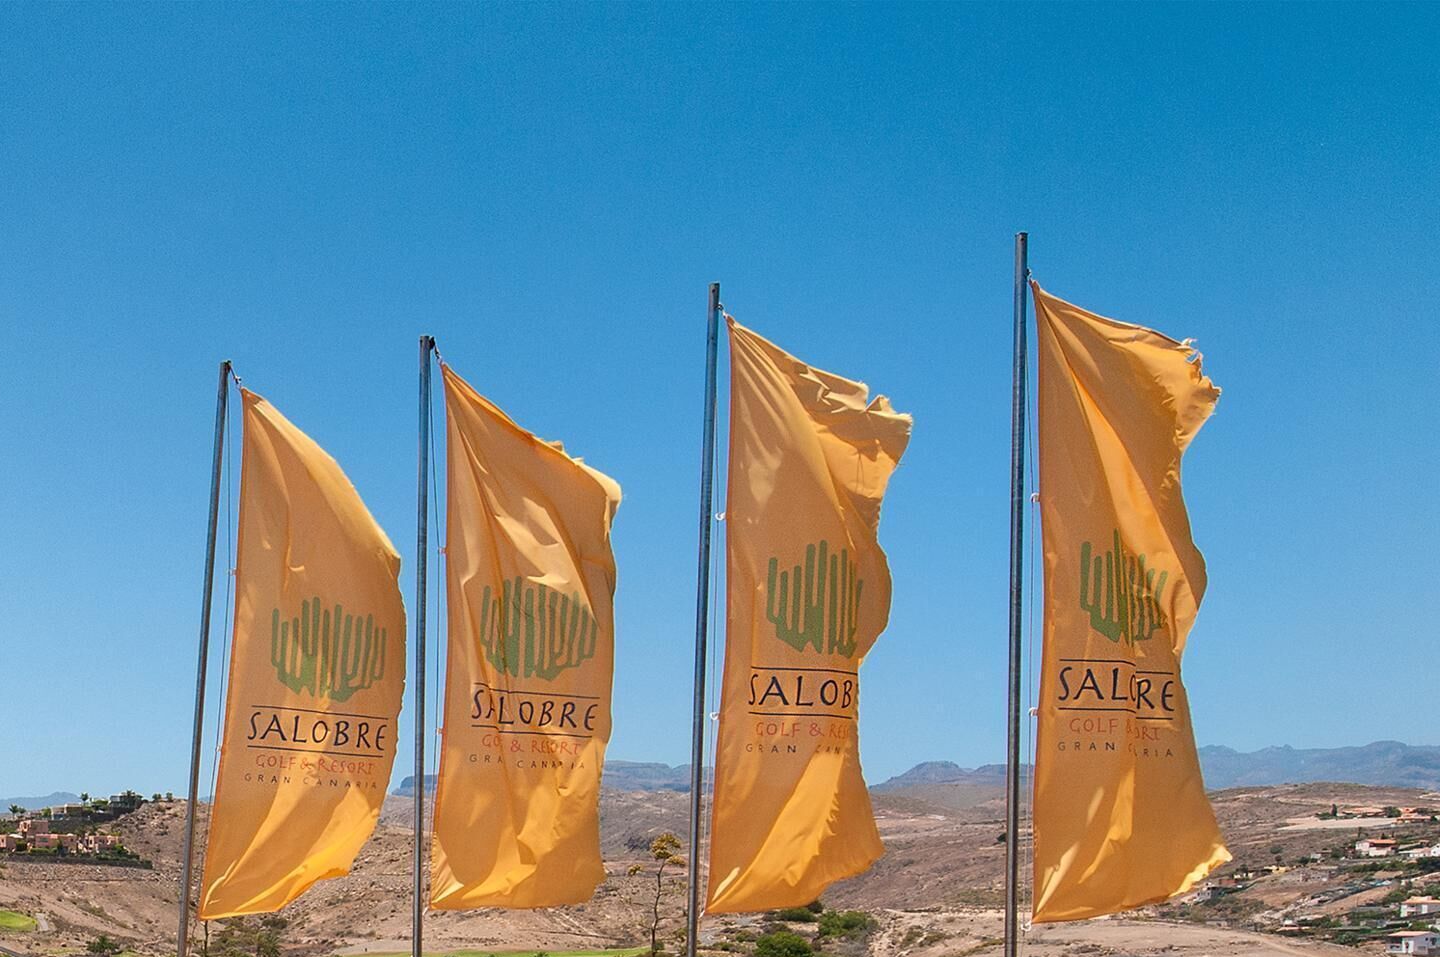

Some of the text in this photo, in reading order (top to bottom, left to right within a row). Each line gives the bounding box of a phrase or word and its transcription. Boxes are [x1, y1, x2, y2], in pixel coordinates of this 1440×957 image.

[748, 673, 853, 709] SALOB
[247, 711, 387, 750] SALOBRE
[756, 722, 801, 738] GOLF
[809, 722, 825, 737] &
[1069, 718, 1119, 734] GOLF
[482, 734, 502, 748] GO
[510, 740, 524, 753] &
[745, 743, 797, 753] GRAN
[1057, 742, 1116, 751] GRAN
[256, 754, 375, 775] GOLF & RESORT
[469, 754, 504, 764] GRA
[244, 772, 377, 789] GRAN CANARIA
